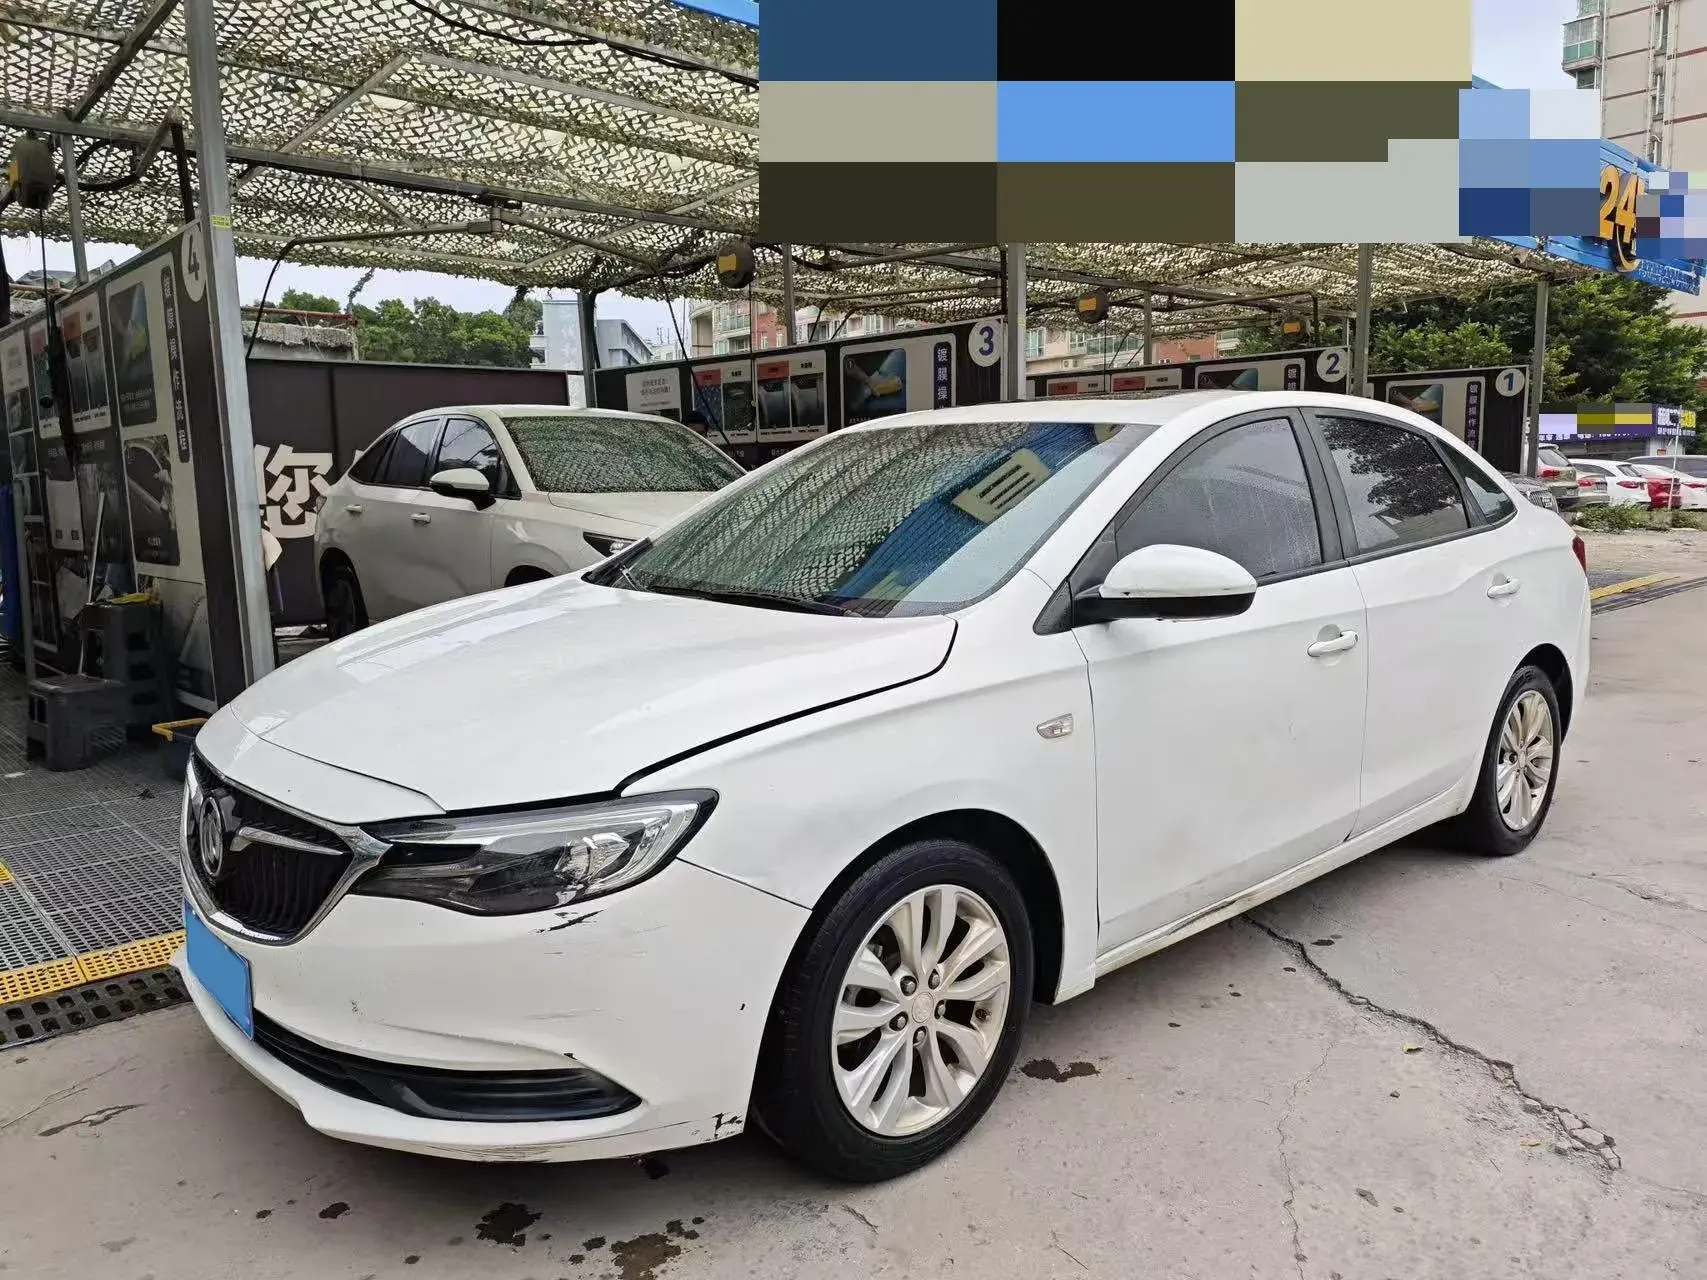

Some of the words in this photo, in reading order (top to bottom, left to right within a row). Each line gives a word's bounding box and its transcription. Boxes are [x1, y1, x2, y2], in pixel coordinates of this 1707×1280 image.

[1600, 165, 1638, 244] 24
[188, 236, 199, 281] 4
[979, 326, 994, 356] 3
[1326, 353, 1340, 374] 2
[937, 348, 948, 409] 镀膜操
[1503, 372, 1515, 391] 1
[254, 444, 333, 538] 您
